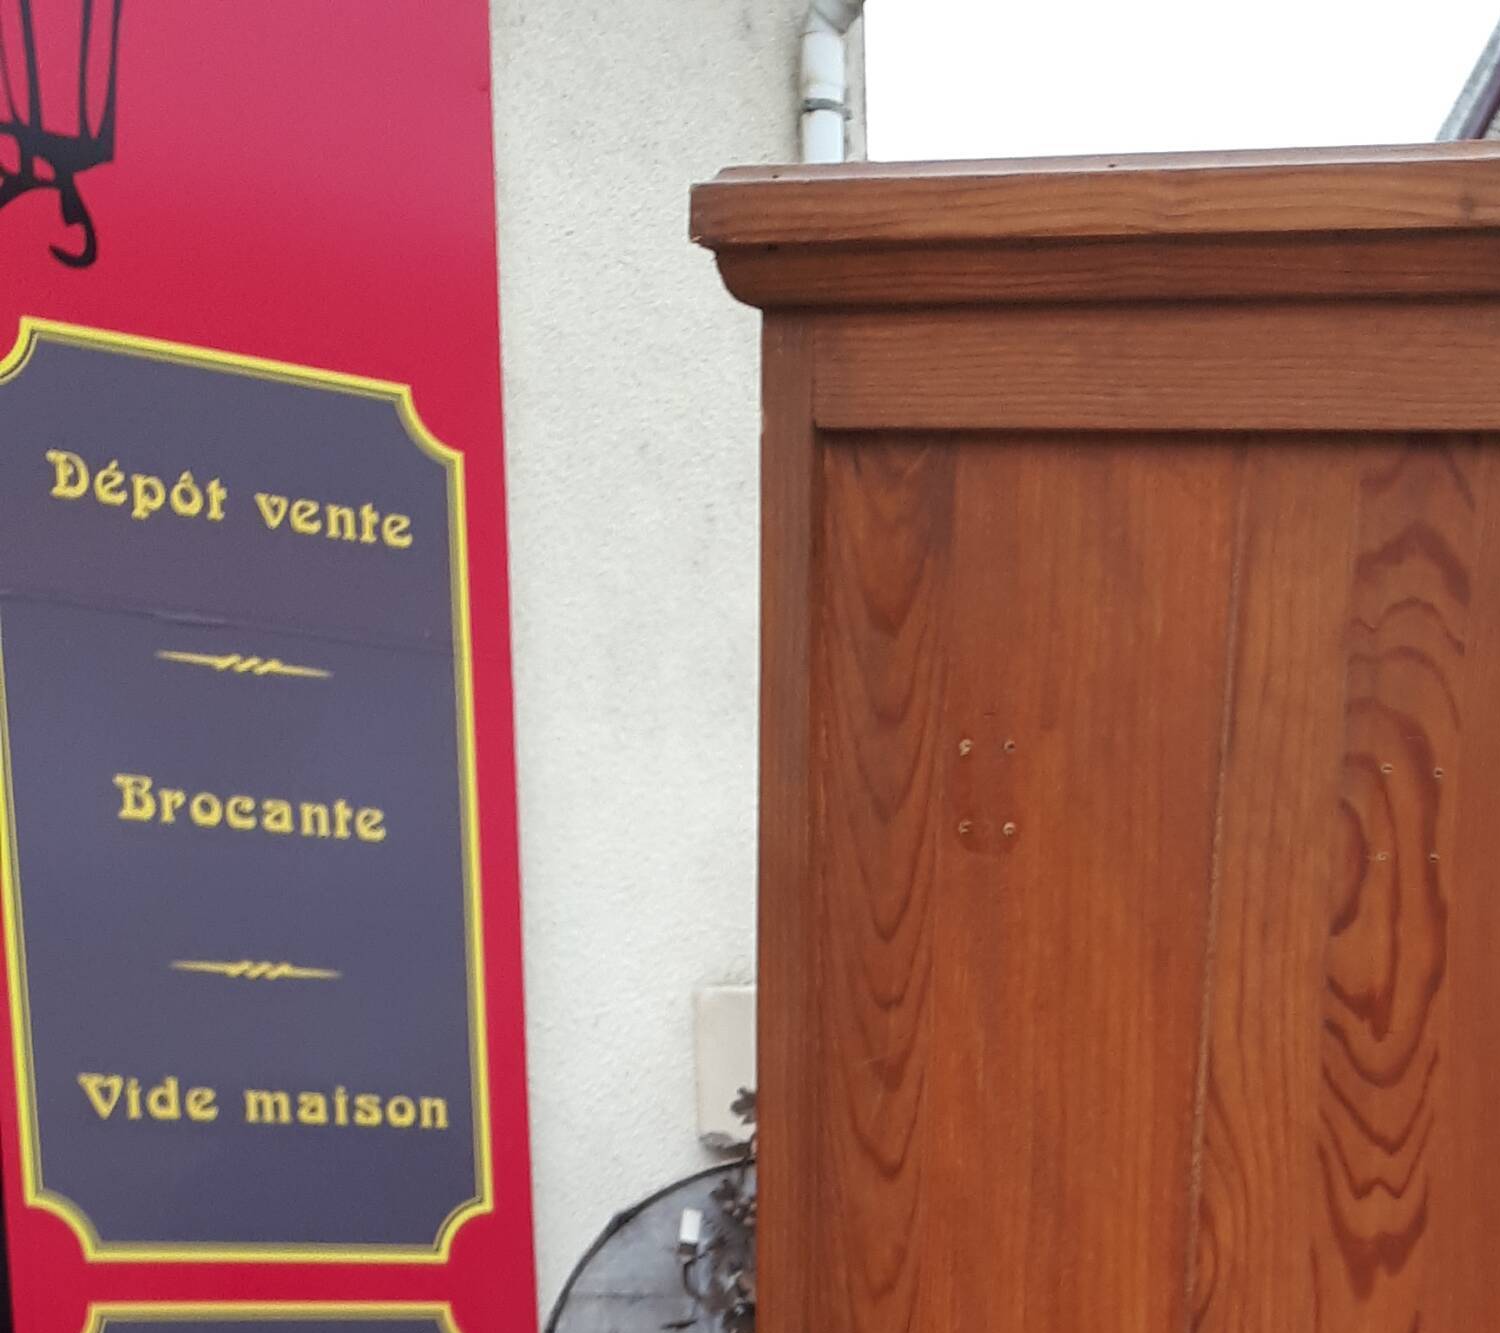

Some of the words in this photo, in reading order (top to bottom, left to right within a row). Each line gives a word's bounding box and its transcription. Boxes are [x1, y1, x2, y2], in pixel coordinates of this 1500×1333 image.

[46, 449, 228, 521] Dépôt
[255, 492, 412, 548] vente
[113, 773, 387, 842] Brocante
[78, 1072, 219, 1120] Vide
[243, 1084, 449, 1128] maison
